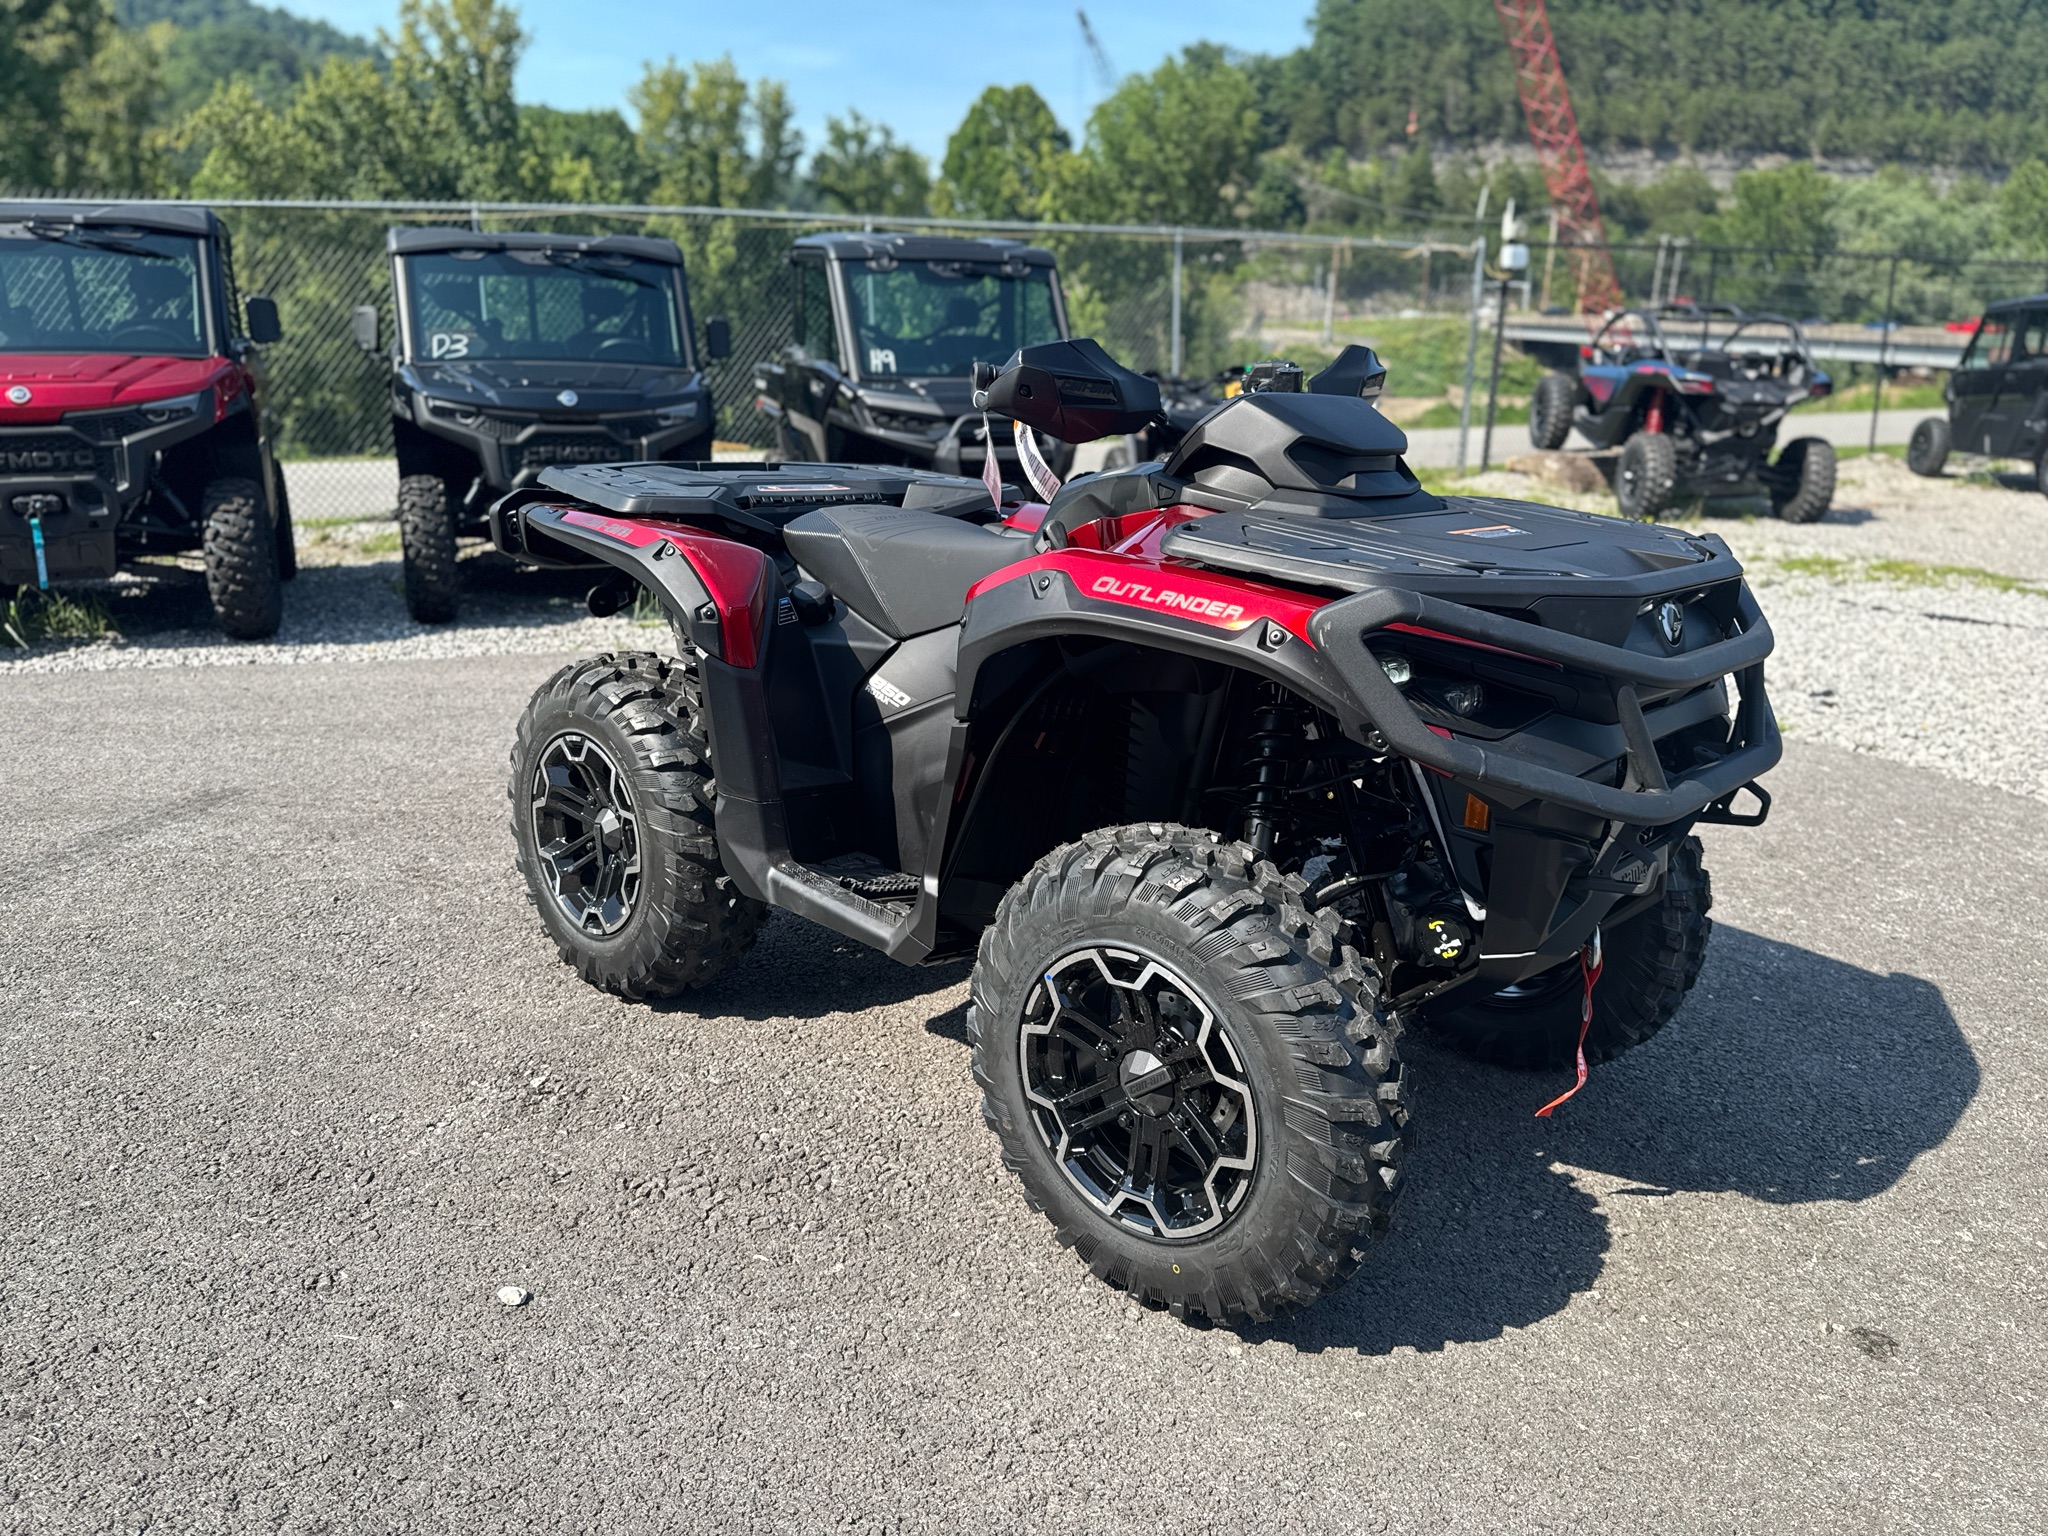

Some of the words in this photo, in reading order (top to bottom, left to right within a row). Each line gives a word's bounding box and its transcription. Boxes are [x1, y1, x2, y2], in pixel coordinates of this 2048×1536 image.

[432, 333, 469, 360] D3
[869, 348, 898, 374] H9
[523, 446, 621, 461] CFMOTO
[1092, 576, 1244, 620] OUTLANDER
[868, 673, 912, 706] 850
[1130, 1071, 1167, 1095] can-am
